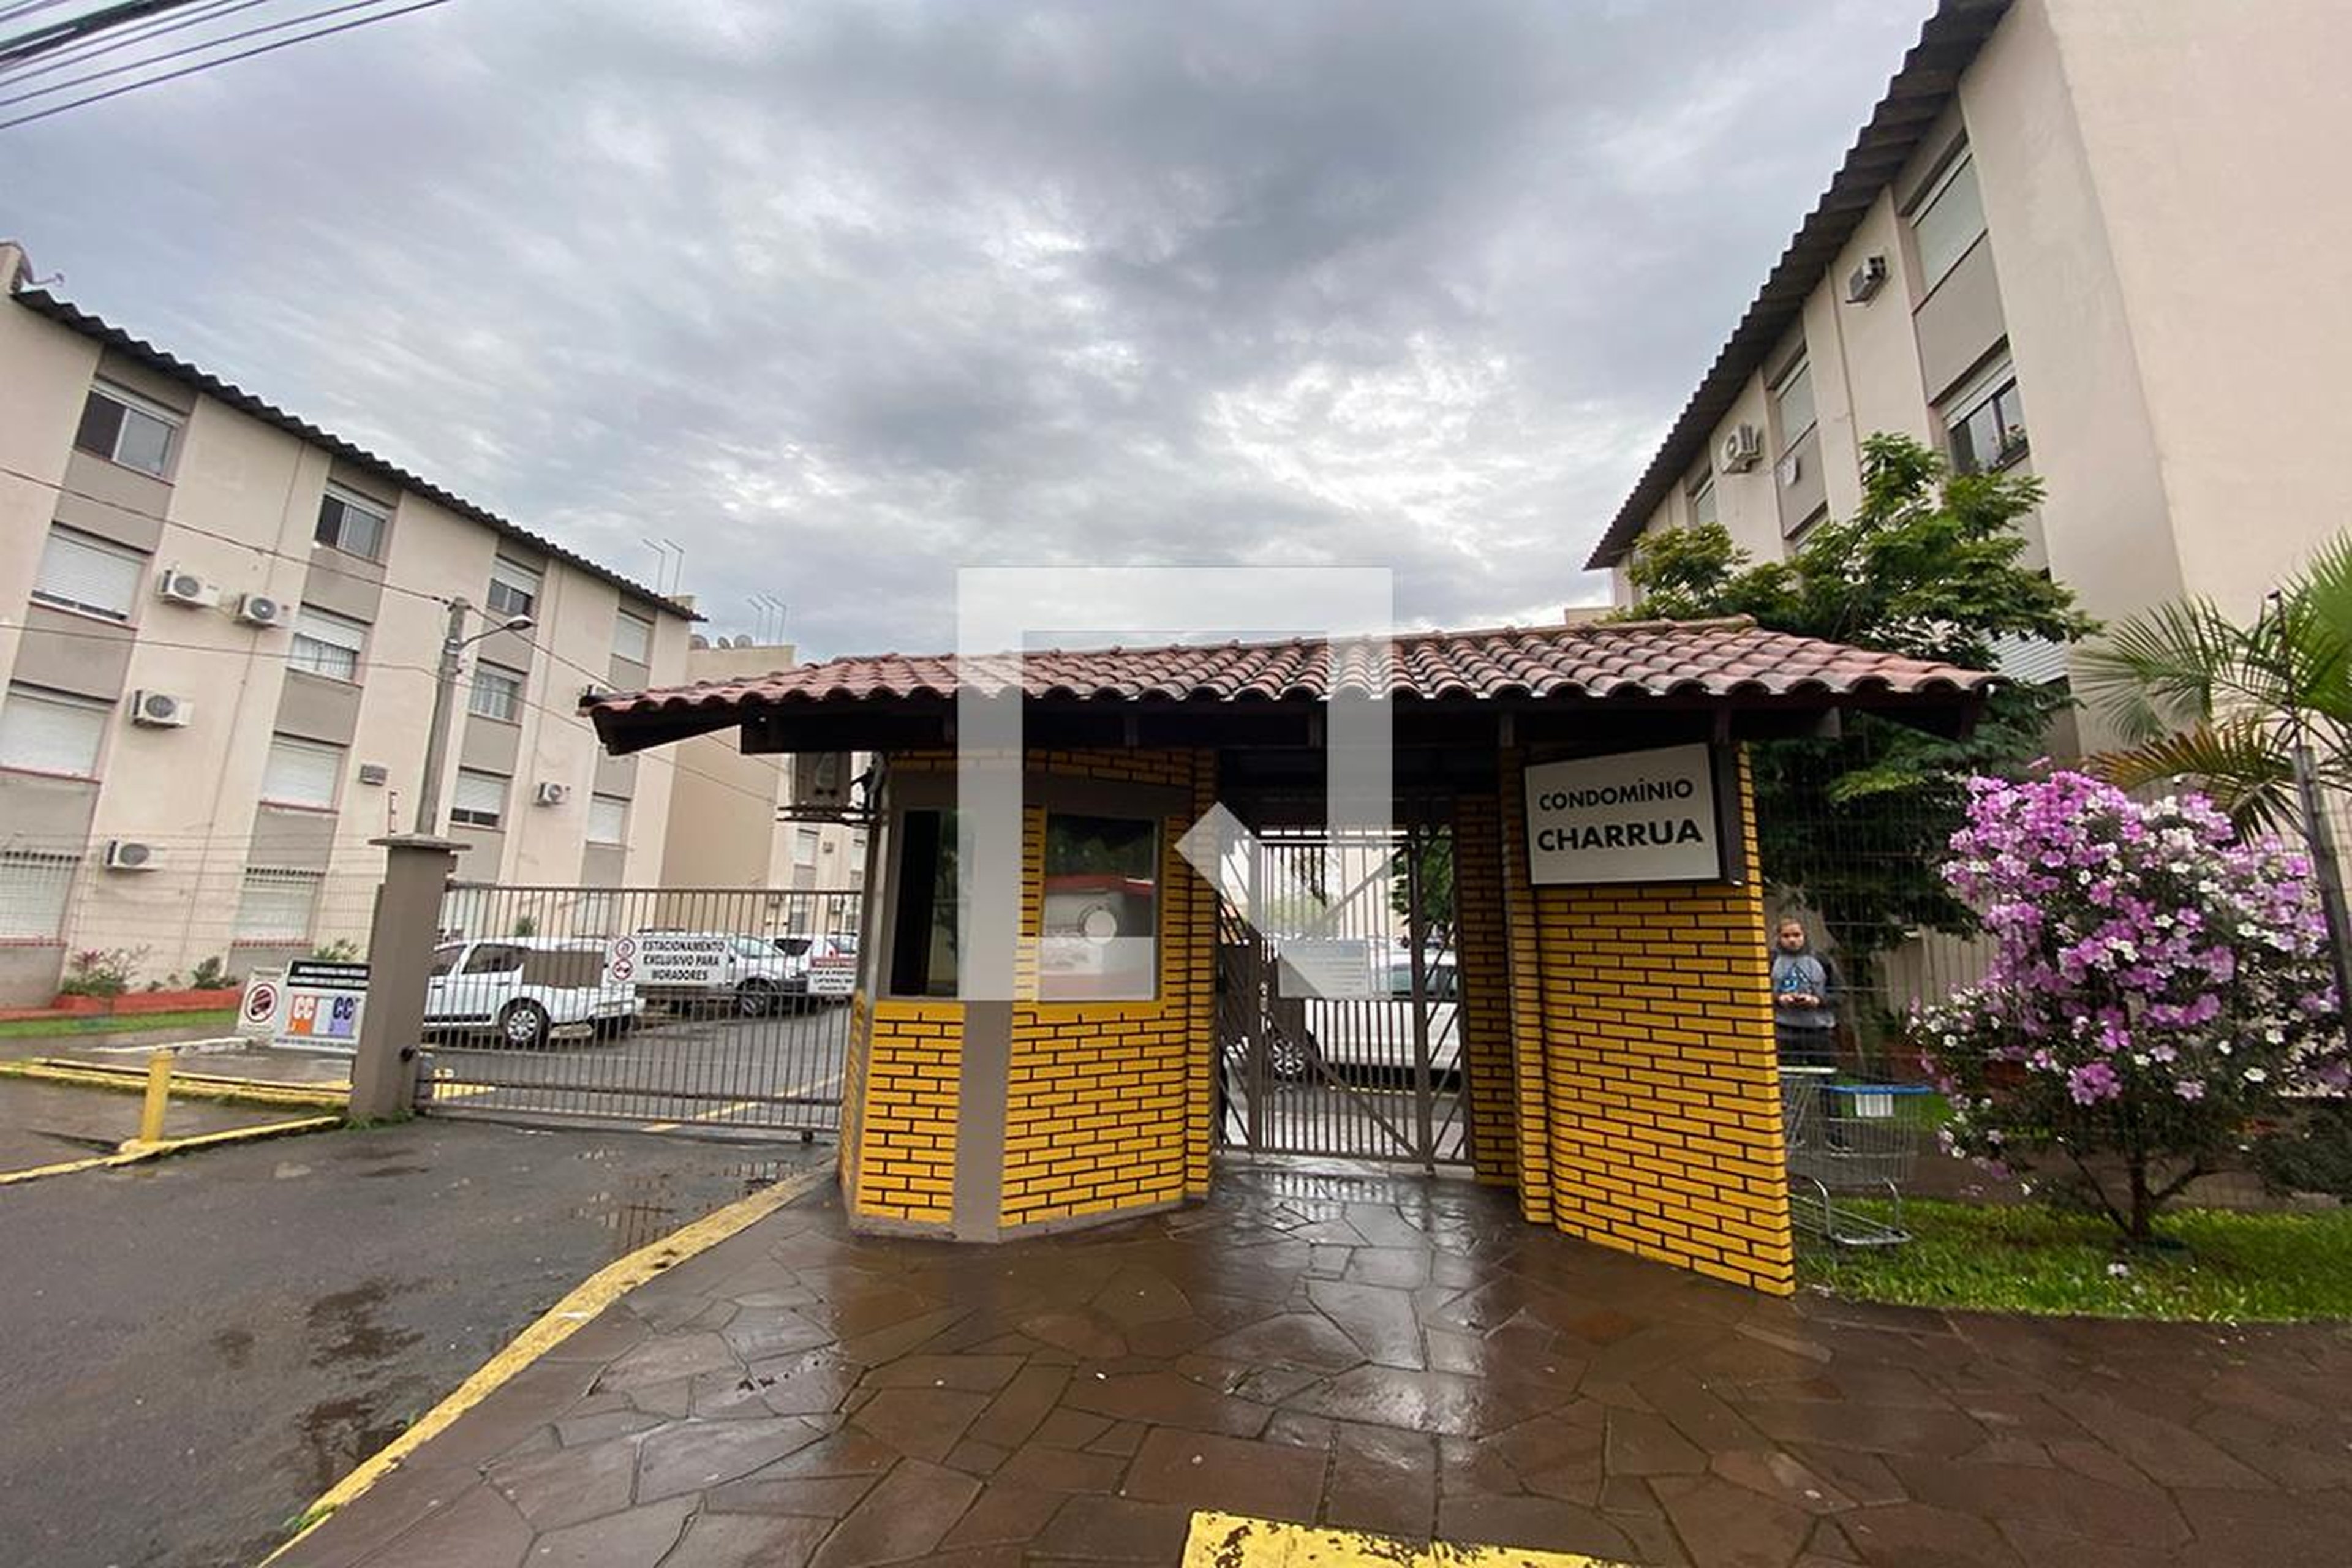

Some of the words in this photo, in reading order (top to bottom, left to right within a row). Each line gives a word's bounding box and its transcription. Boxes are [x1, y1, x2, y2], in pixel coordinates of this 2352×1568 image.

[1539, 777, 1694, 811] CONDOMÍNIO
[1537, 819, 1703, 851] CHARRUA
[643, 940, 725, 952] ESTACIONAMENTO
[643, 954, 695, 966] EXCLUSIVO
[696, 955, 720, 966] PARA
[652, 969, 709, 981] MORADORES
